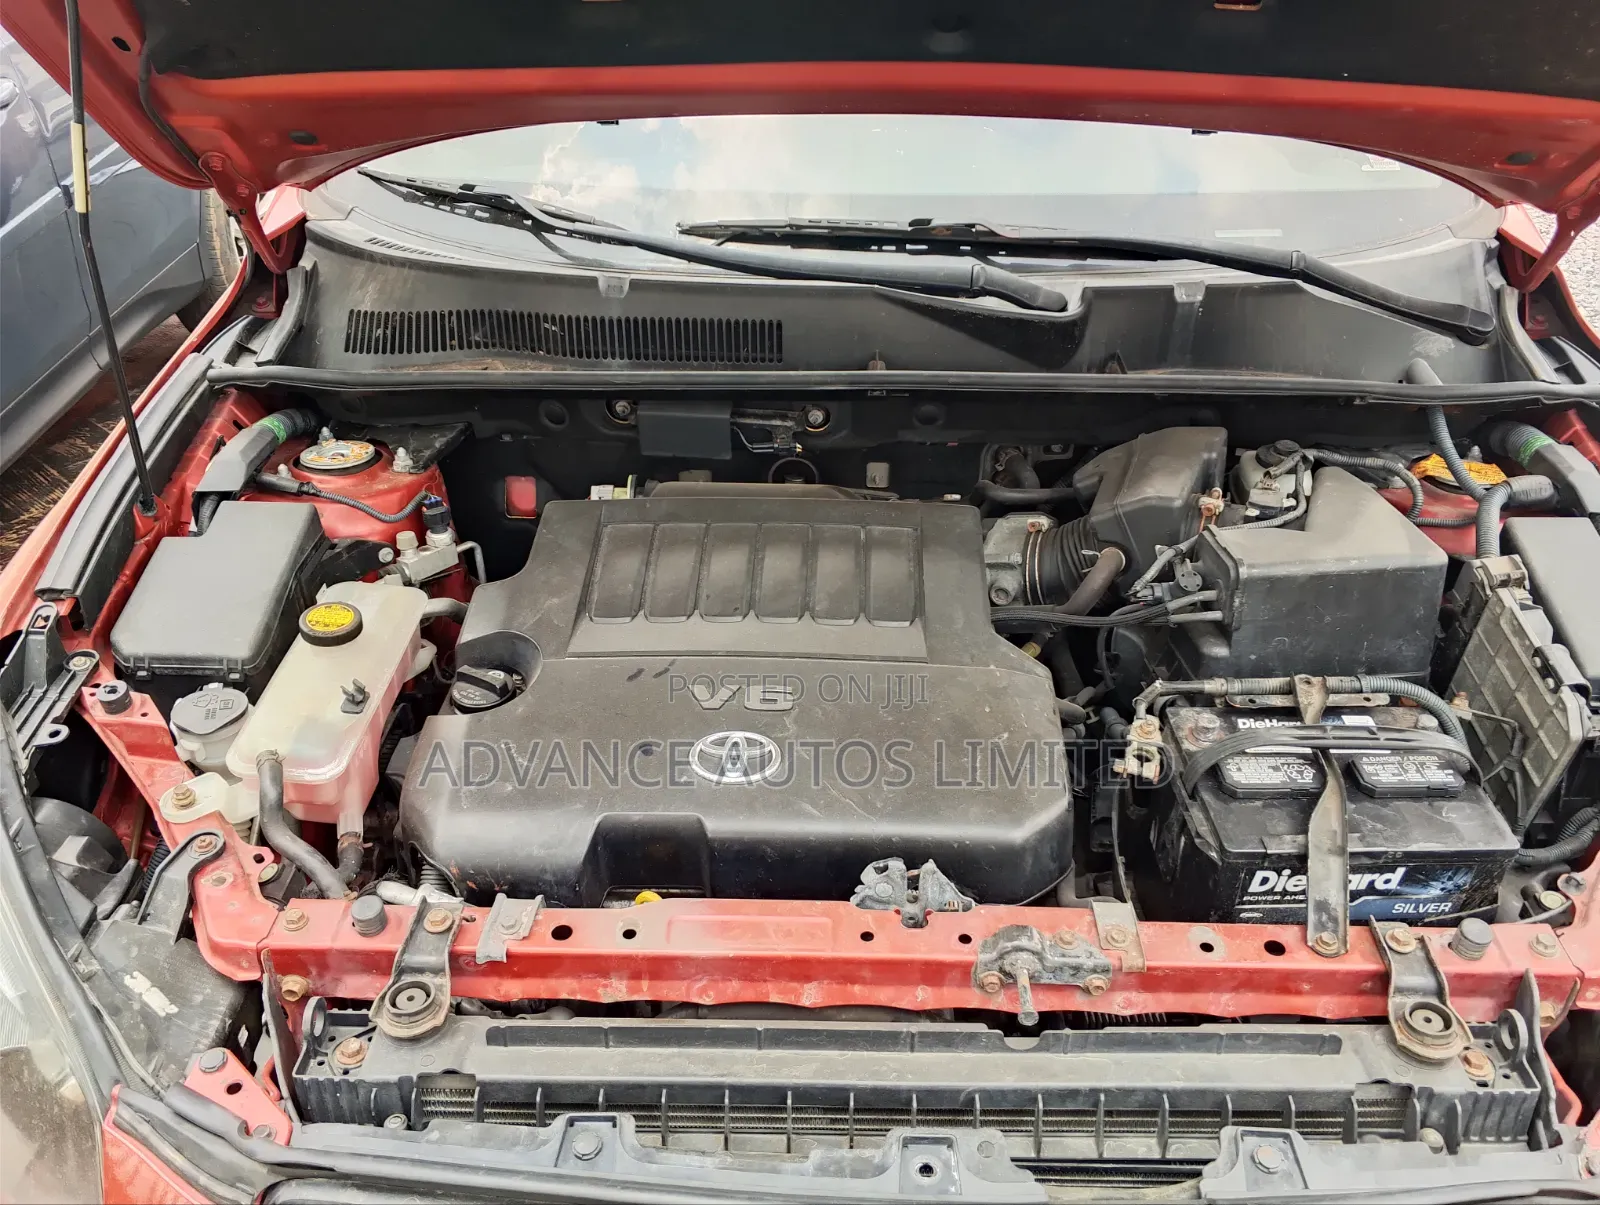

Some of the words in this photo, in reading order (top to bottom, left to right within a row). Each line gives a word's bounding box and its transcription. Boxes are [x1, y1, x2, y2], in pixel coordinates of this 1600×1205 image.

[687, 684, 794, 712] V6
[1248, 868, 1406, 893] Dieard
[1392, 902, 1452, 914] SILVER
